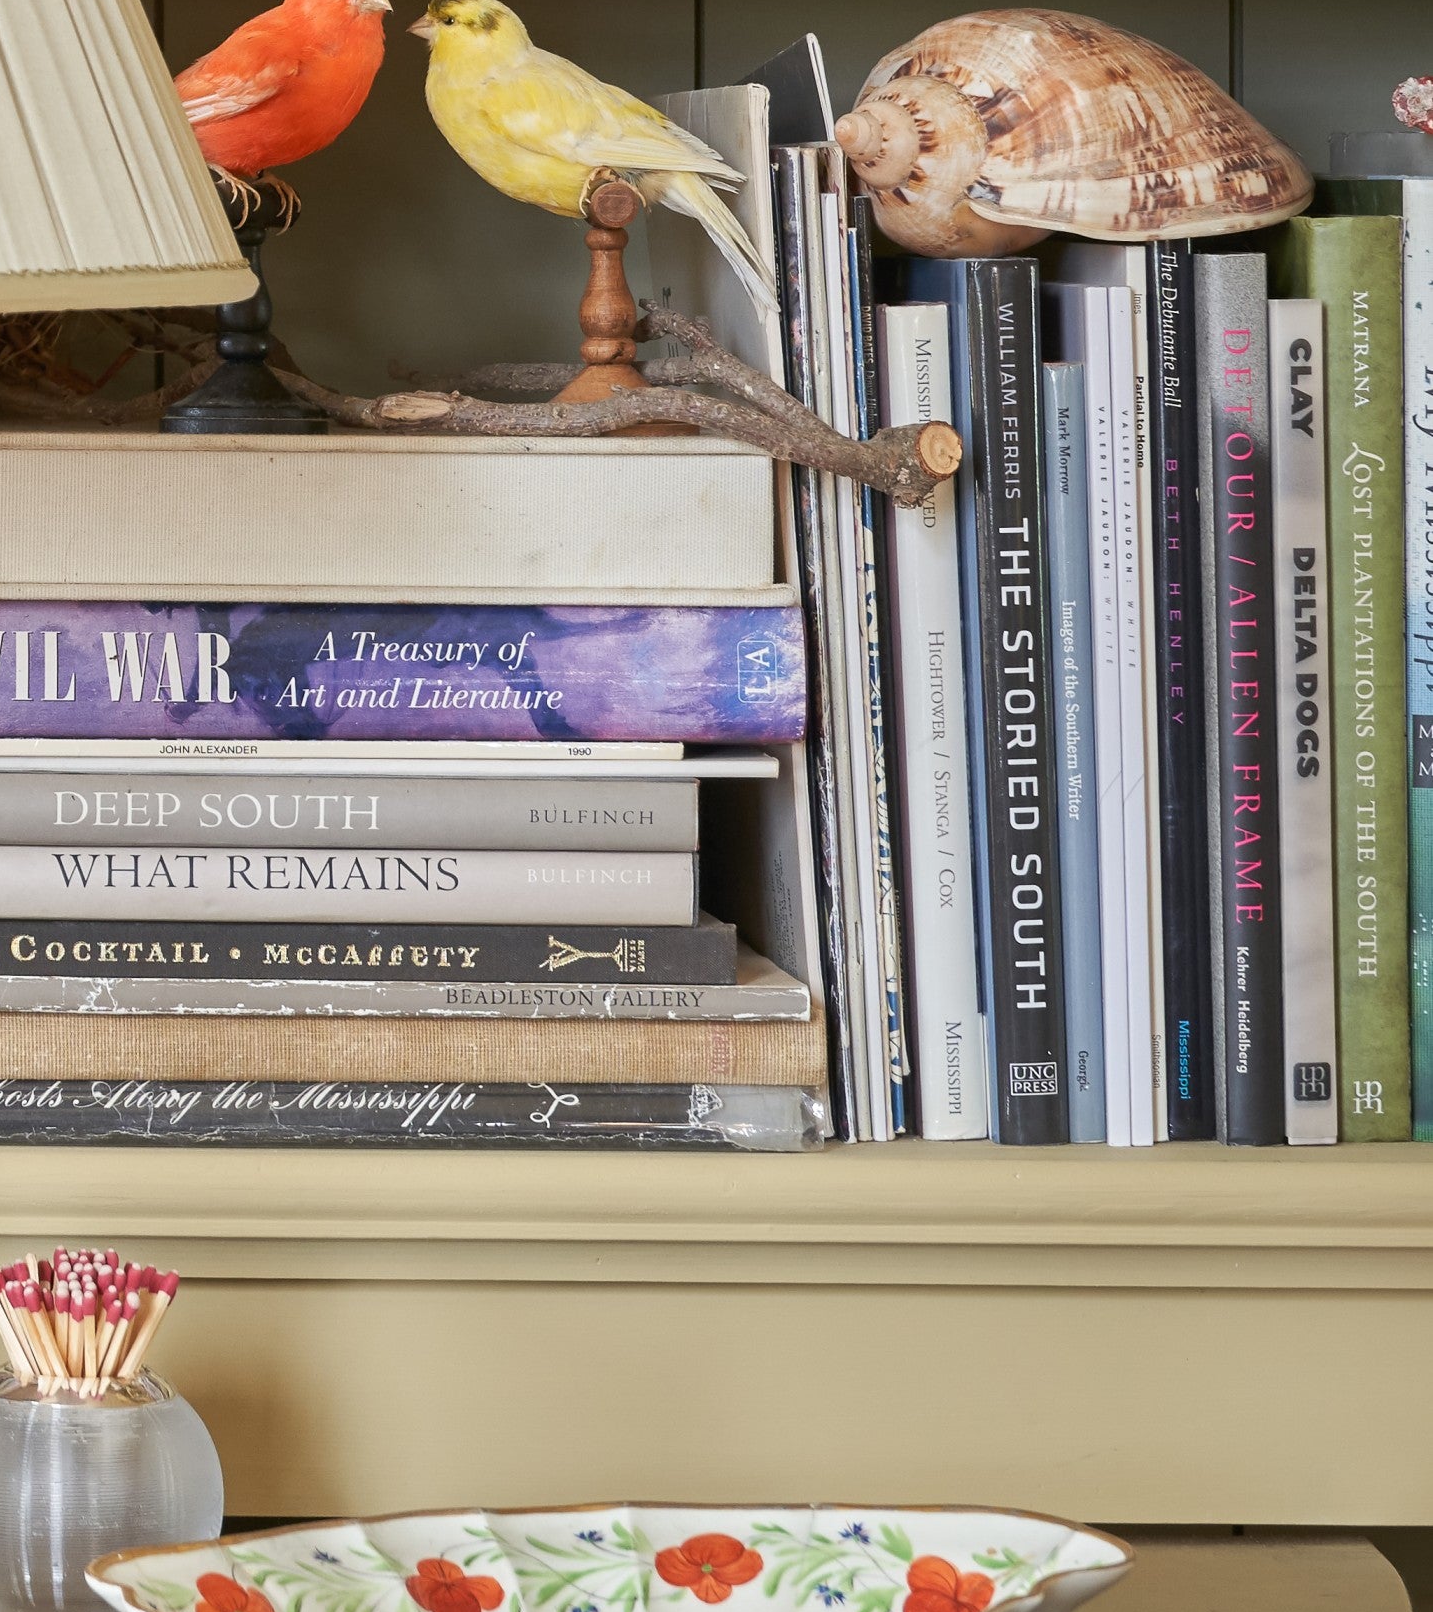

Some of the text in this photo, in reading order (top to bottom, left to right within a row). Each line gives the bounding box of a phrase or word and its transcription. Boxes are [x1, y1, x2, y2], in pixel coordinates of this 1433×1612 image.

[104, 632, 236, 704] WAR
[314, 631, 534, 671] A Treasury of
[277, 677, 563, 714] Art and Literature
[159, 744, 258, 756] JOHN ALEXANDER
[567, 747, 592, 757] 1990
[999, 516, 1047, 1011] THE STORIED SOUTH
[53, 791, 182, 828] DEEP
[197, 794, 380, 830] SOUTH
[529, 809, 655, 825] BULFINCH
[54, 853, 209, 891] WHAT
[226, 855, 459, 892] REMAINS
[10, 934, 210, 964] COCKTAIL
[446, 987, 703, 1008] BEADLESTON GALLERY
